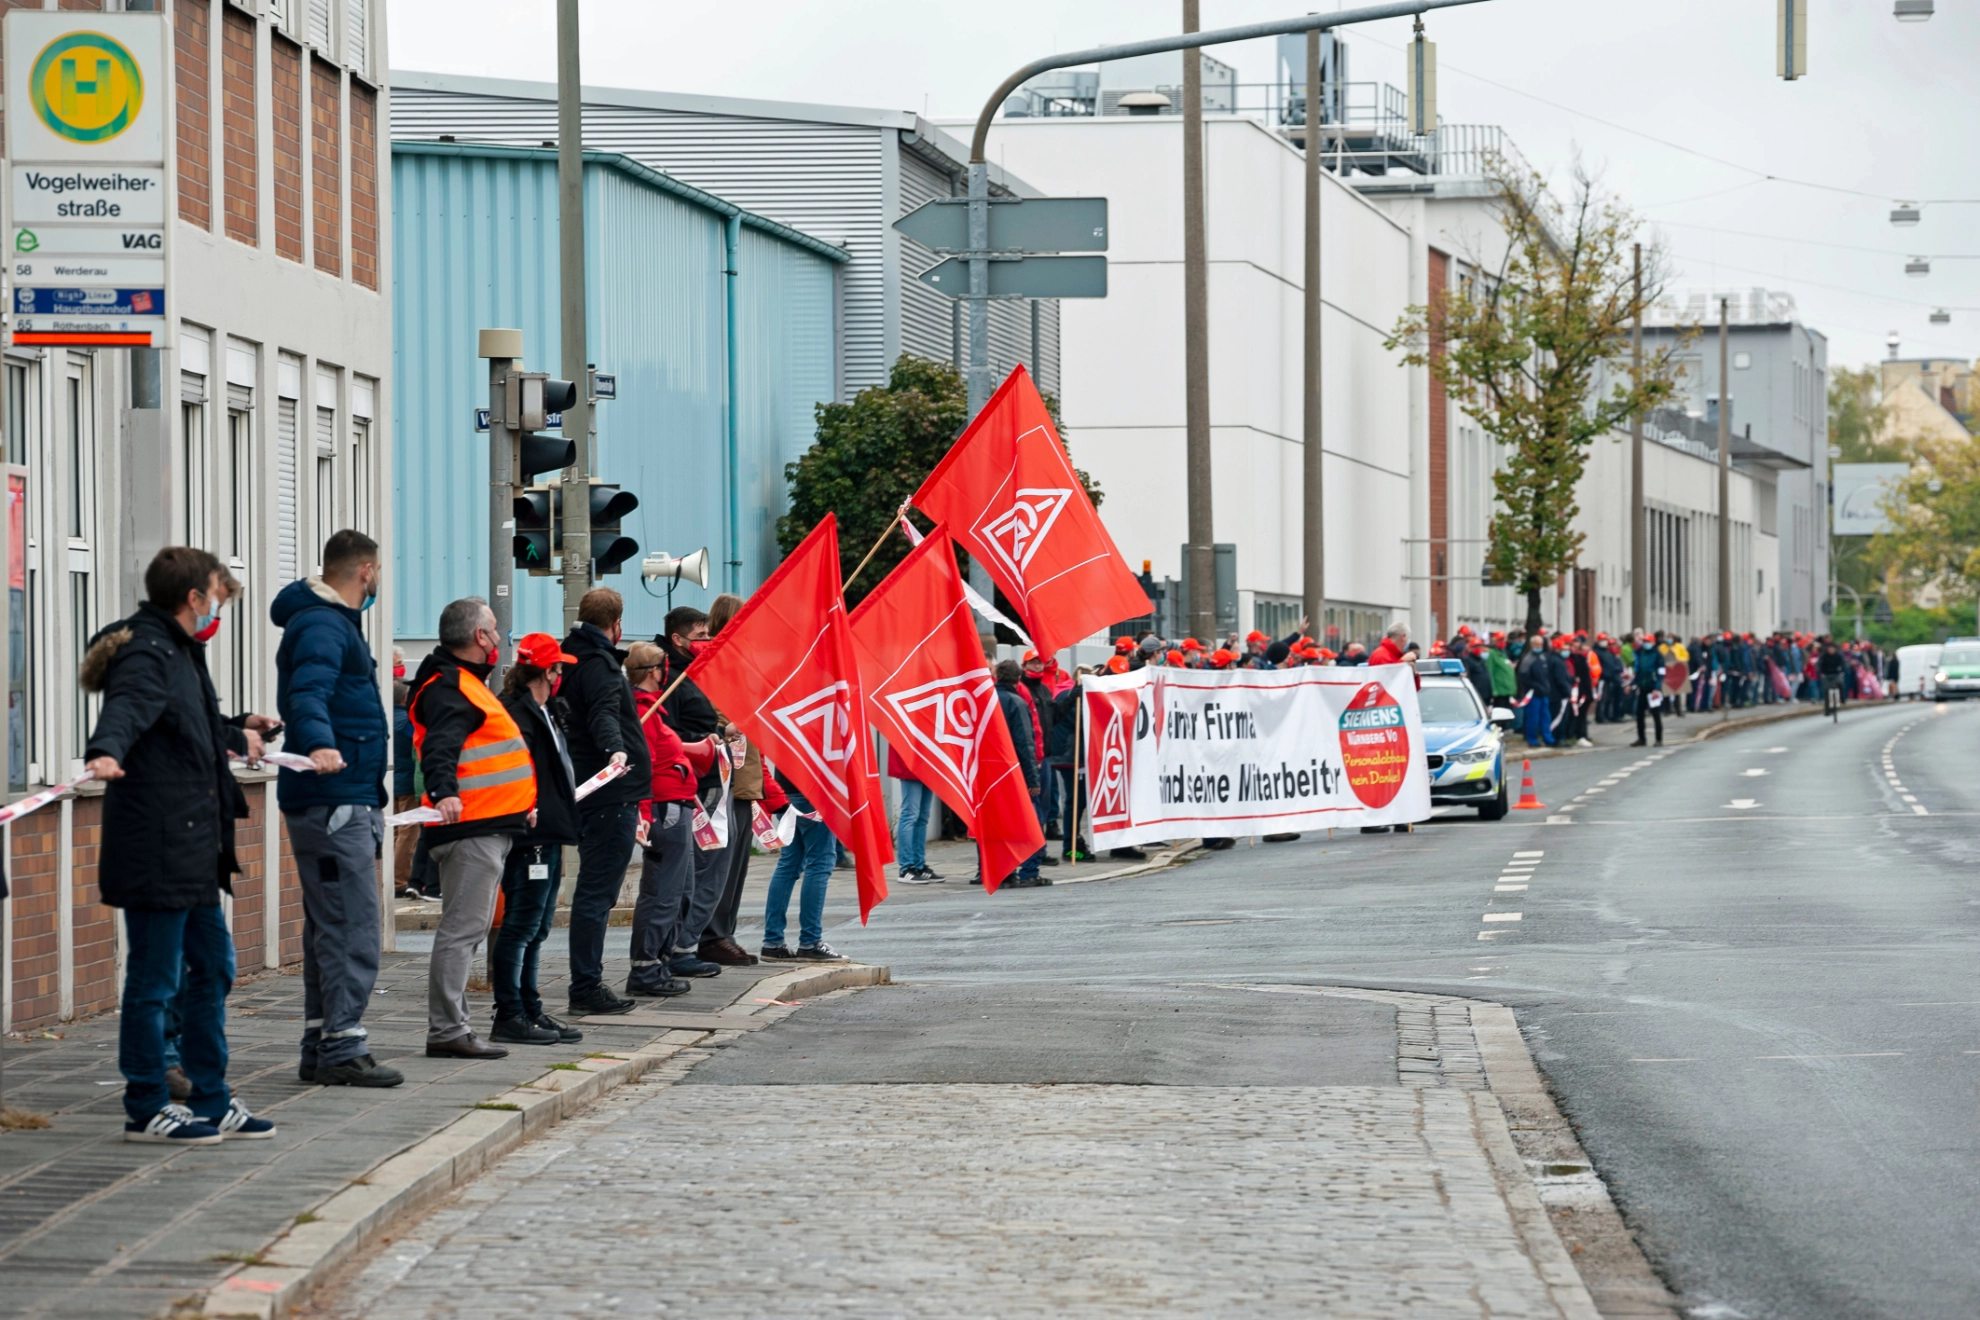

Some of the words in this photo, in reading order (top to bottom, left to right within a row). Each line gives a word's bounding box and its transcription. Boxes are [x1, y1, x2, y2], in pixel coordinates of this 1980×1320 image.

[61, 58, 111, 116] H
[25, 172, 156, 194] Vogelweiher-
[57, 199, 121, 217] straße
[122, 233, 162, 249] VAG
[16, 264, 32, 275] 58
[54, 266, 108, 276] Werderau
[19, 304, 35, 313] N6
[53, 304, 132, 314] Hauptbahnhof
[17, 319, 32, 331] 65
[1342, 707, 1400, 728] SIEMENS
[1343, 749, 1407, 767] Personalabbau
[1187, 765, 1230, 803] seine
[1238, 758, 1341, 803] Mitarbeitr
[1351, 773, 1369, 786] nein
